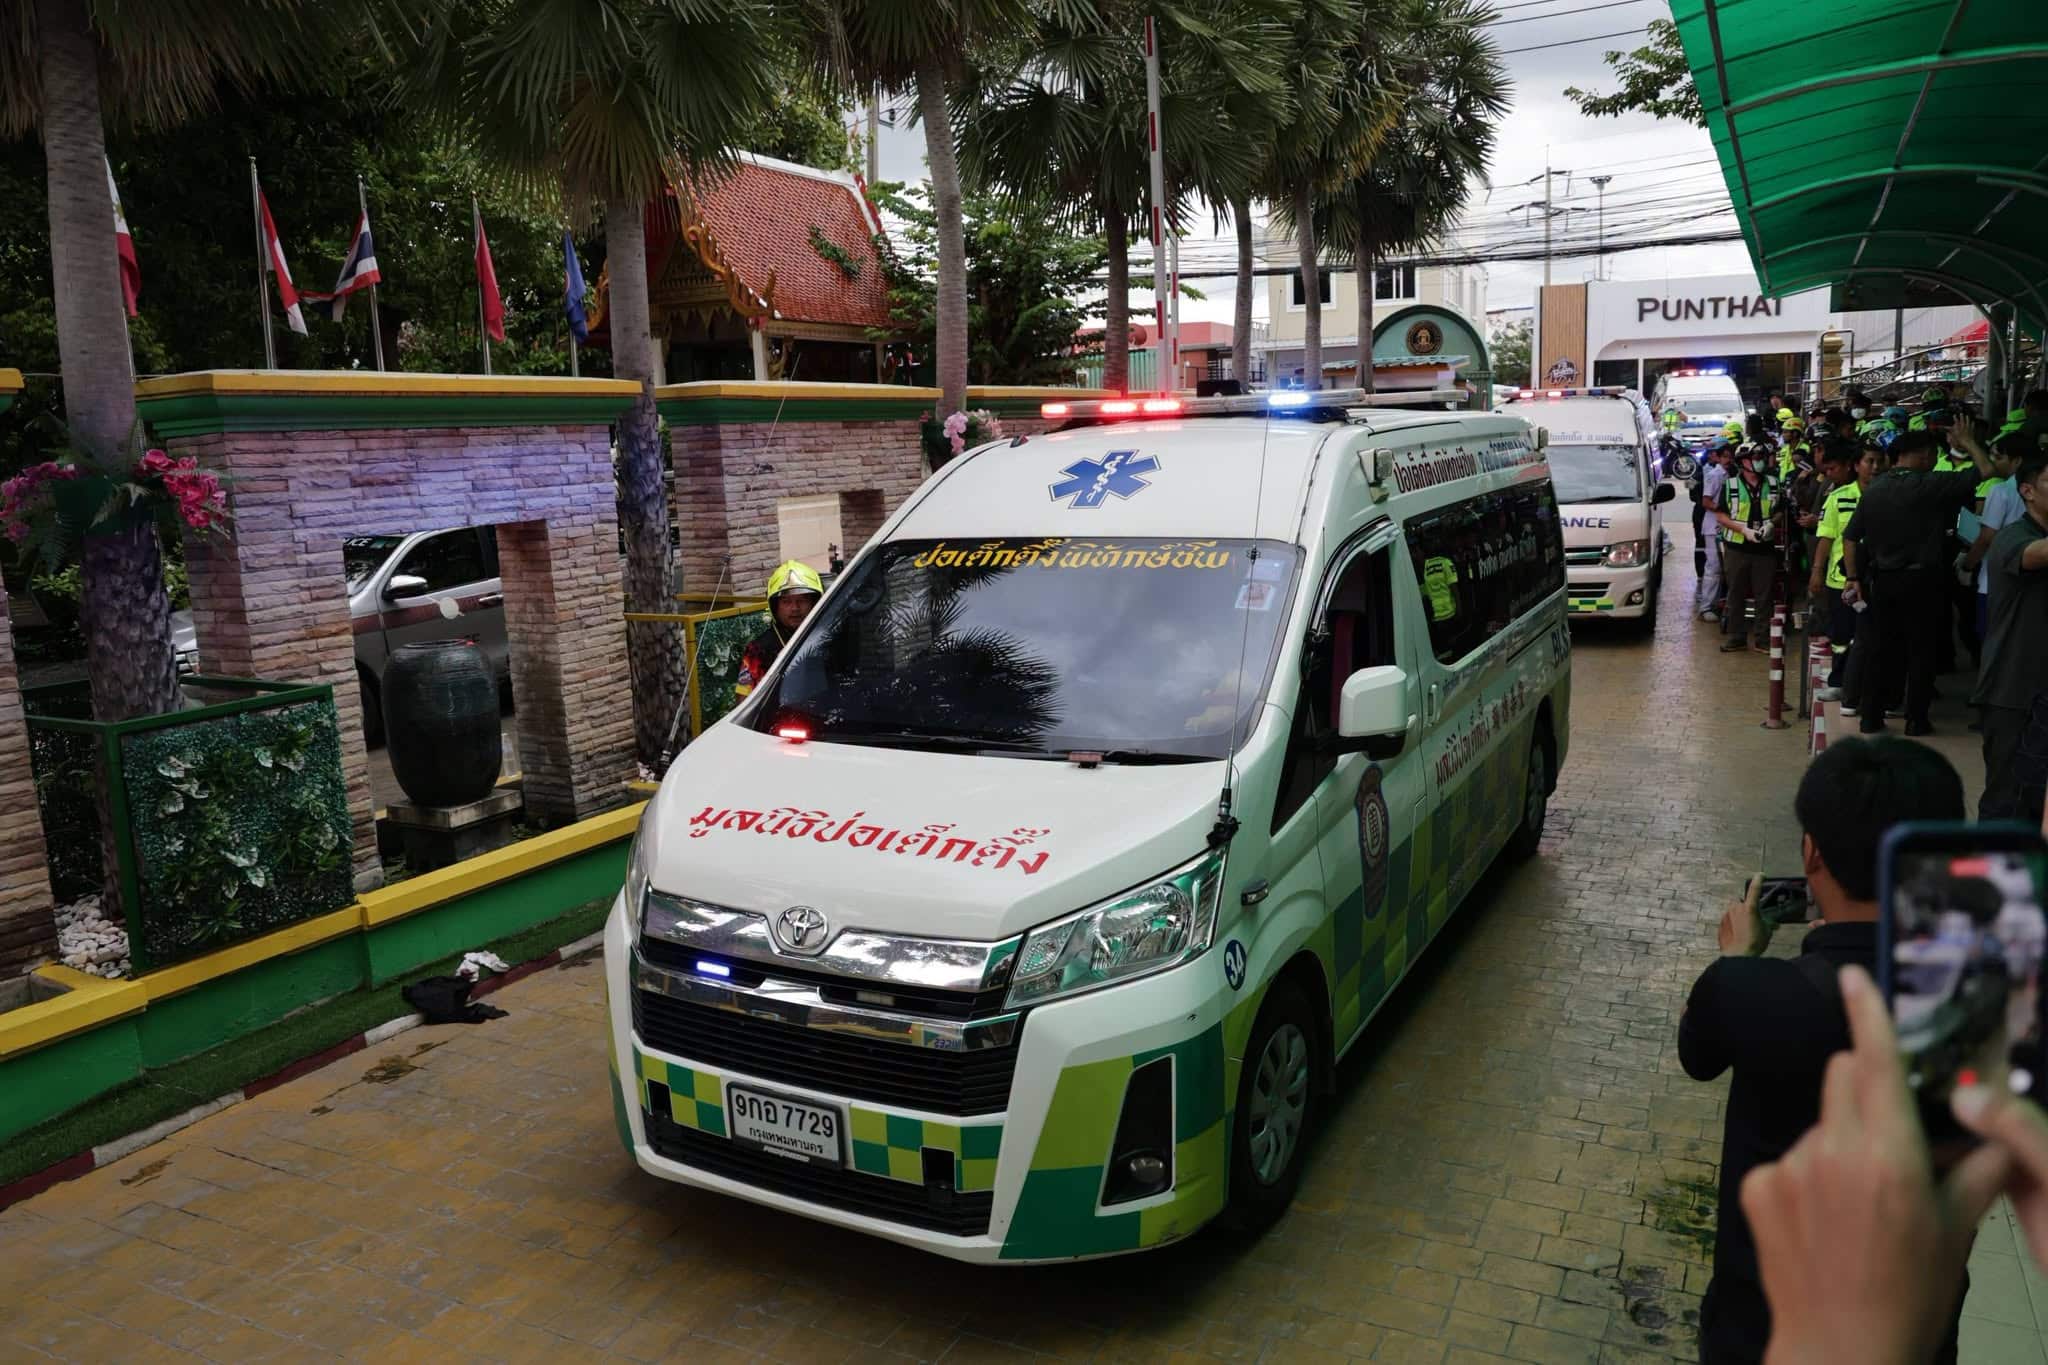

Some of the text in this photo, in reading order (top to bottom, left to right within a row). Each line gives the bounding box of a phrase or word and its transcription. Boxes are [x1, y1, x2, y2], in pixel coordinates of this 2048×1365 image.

[1636, 295, 1783, 323] PUNTHAI
[689, 805, 1051, 875] มูลนิธิป่อเต็กตึ๊ง
[1225, 943, 1244, 986] 34
[782, 1105, 834, 1138] 7729
